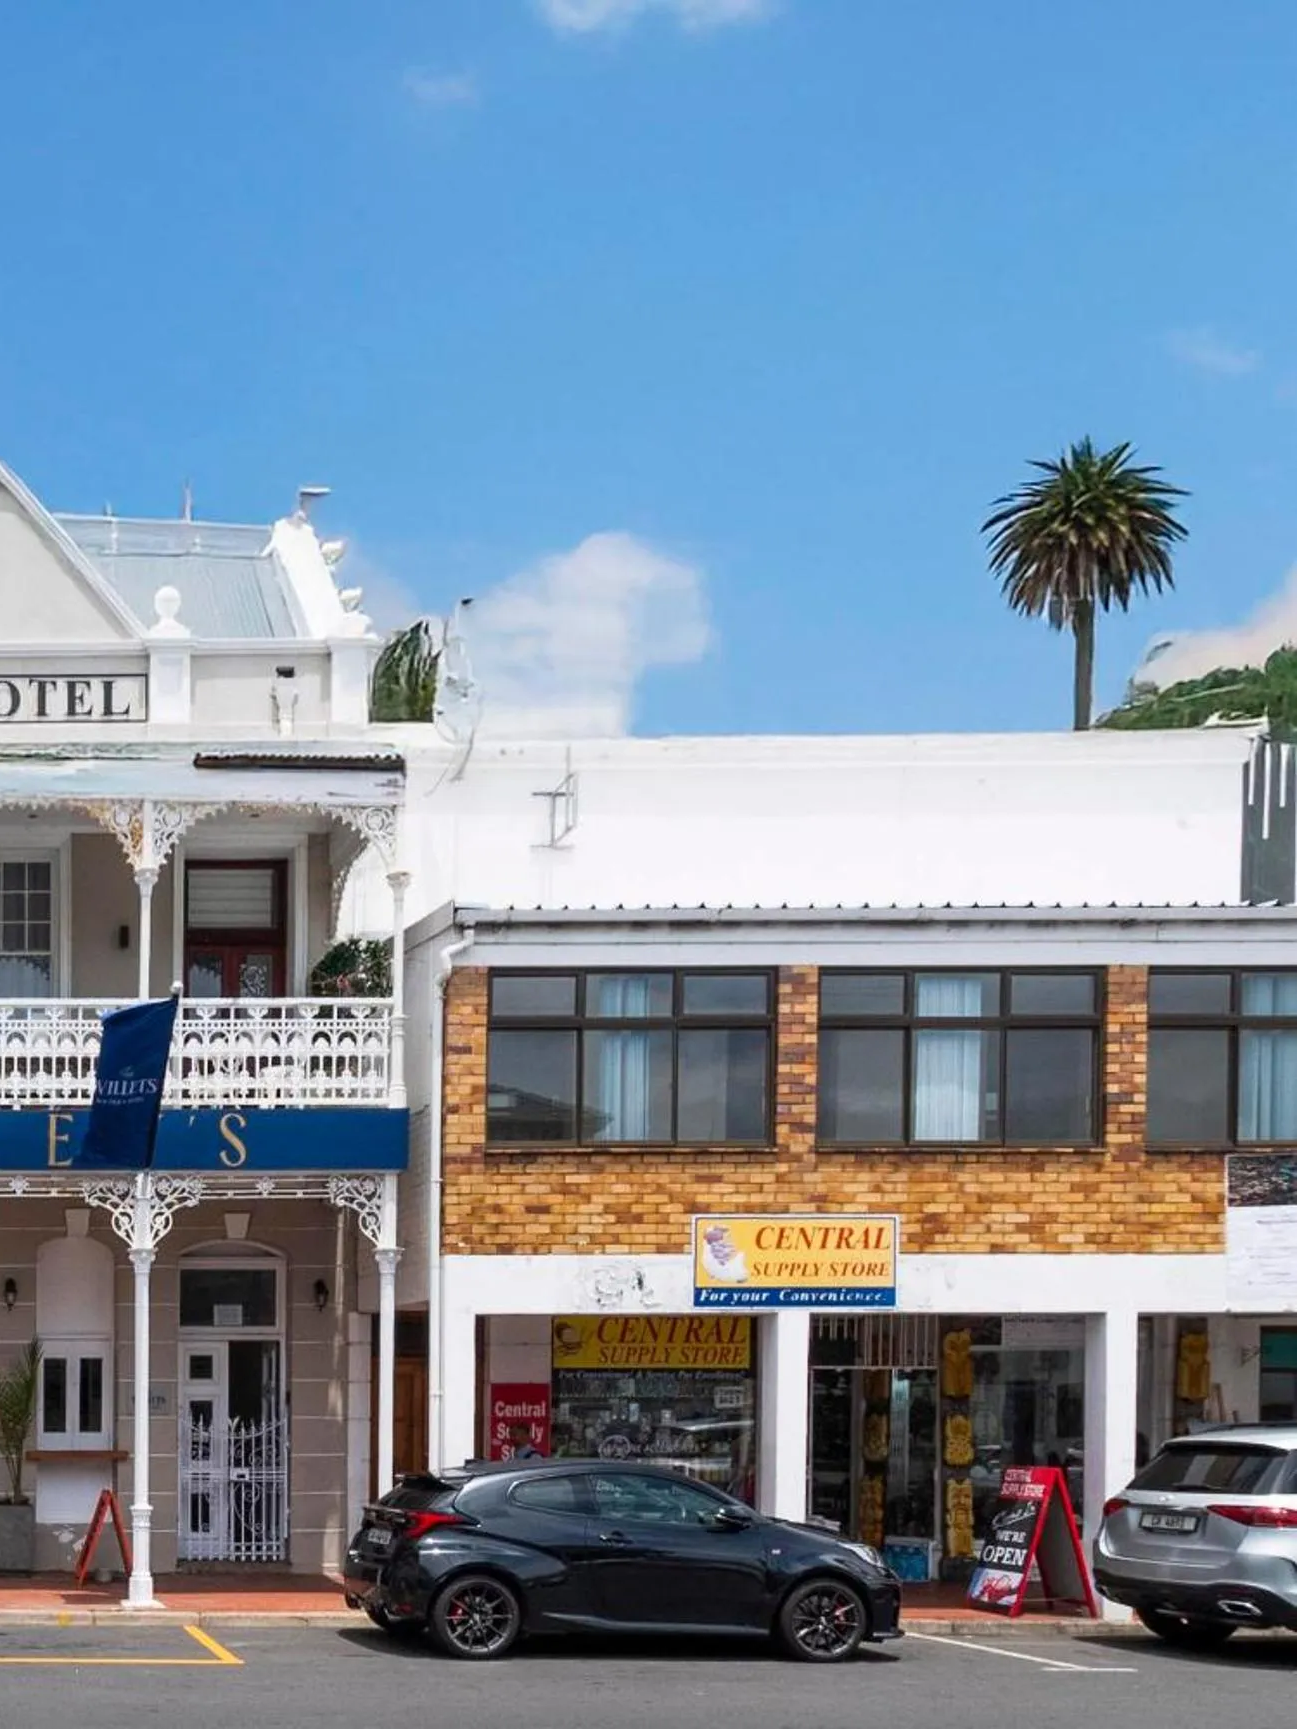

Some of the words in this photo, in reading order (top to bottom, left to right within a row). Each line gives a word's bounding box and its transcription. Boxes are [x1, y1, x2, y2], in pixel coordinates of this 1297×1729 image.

[755, 1225, 891, 1251] CENTRAL
[751, 1261, 825, 1278] SUPPLY
[827, 1261, 890, 1278] STORE
[699, 1289, 729, 1303] For
[731, 1290, 770, 1305] your
[597, 1316, 746, 1344] CENTRAL
[598, 1345, 676, 1365] SUPPLY
[679, 1345, 746, 1365] STORE
[494, 1401, 547, 1418] Central
[496, 1422, 544, 1444] Sly
[995, 1530, 1027, 1543] WE'RE
[982, 1545, 1028, 1567] OPEN
